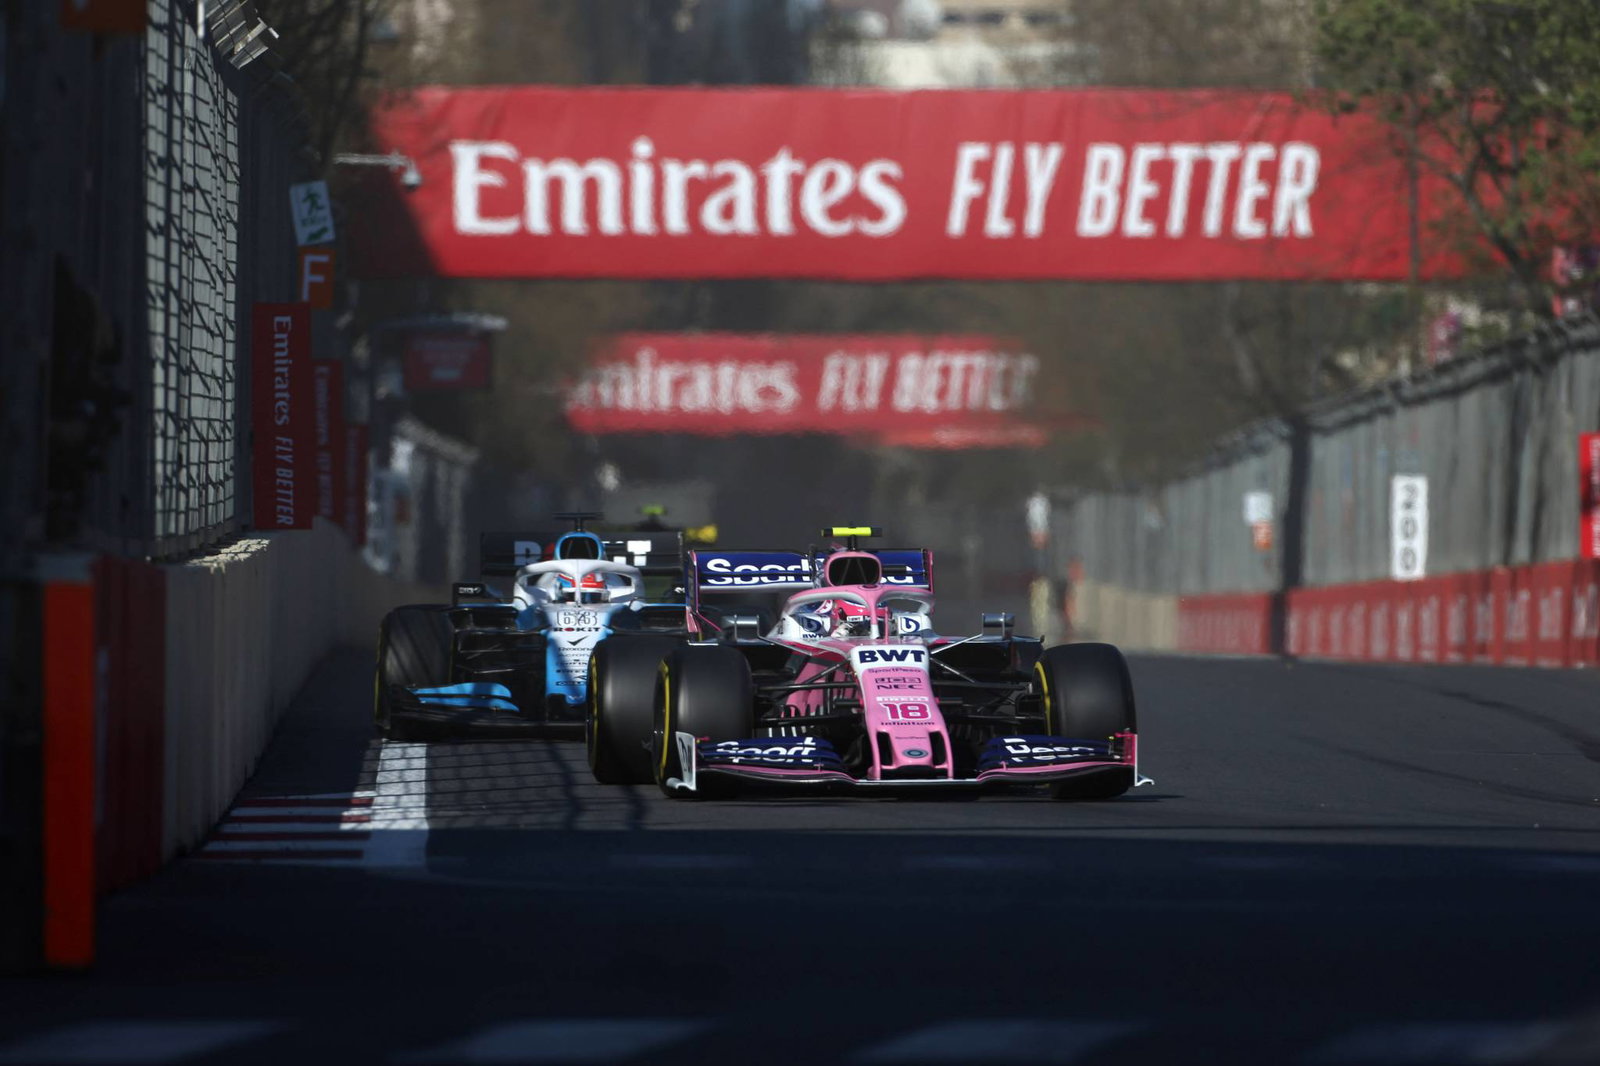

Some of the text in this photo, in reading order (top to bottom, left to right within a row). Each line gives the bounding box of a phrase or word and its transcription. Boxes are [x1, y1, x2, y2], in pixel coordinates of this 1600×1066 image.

[448, 135, 1321, 239] Emirates FLY BETTER
[301, 253, 330, 303] F
[272, 314, 295, 526] Emirates FLY BETTER
[858, 649, 926, 664] BWT
[880, 702, 930, 720] 18
